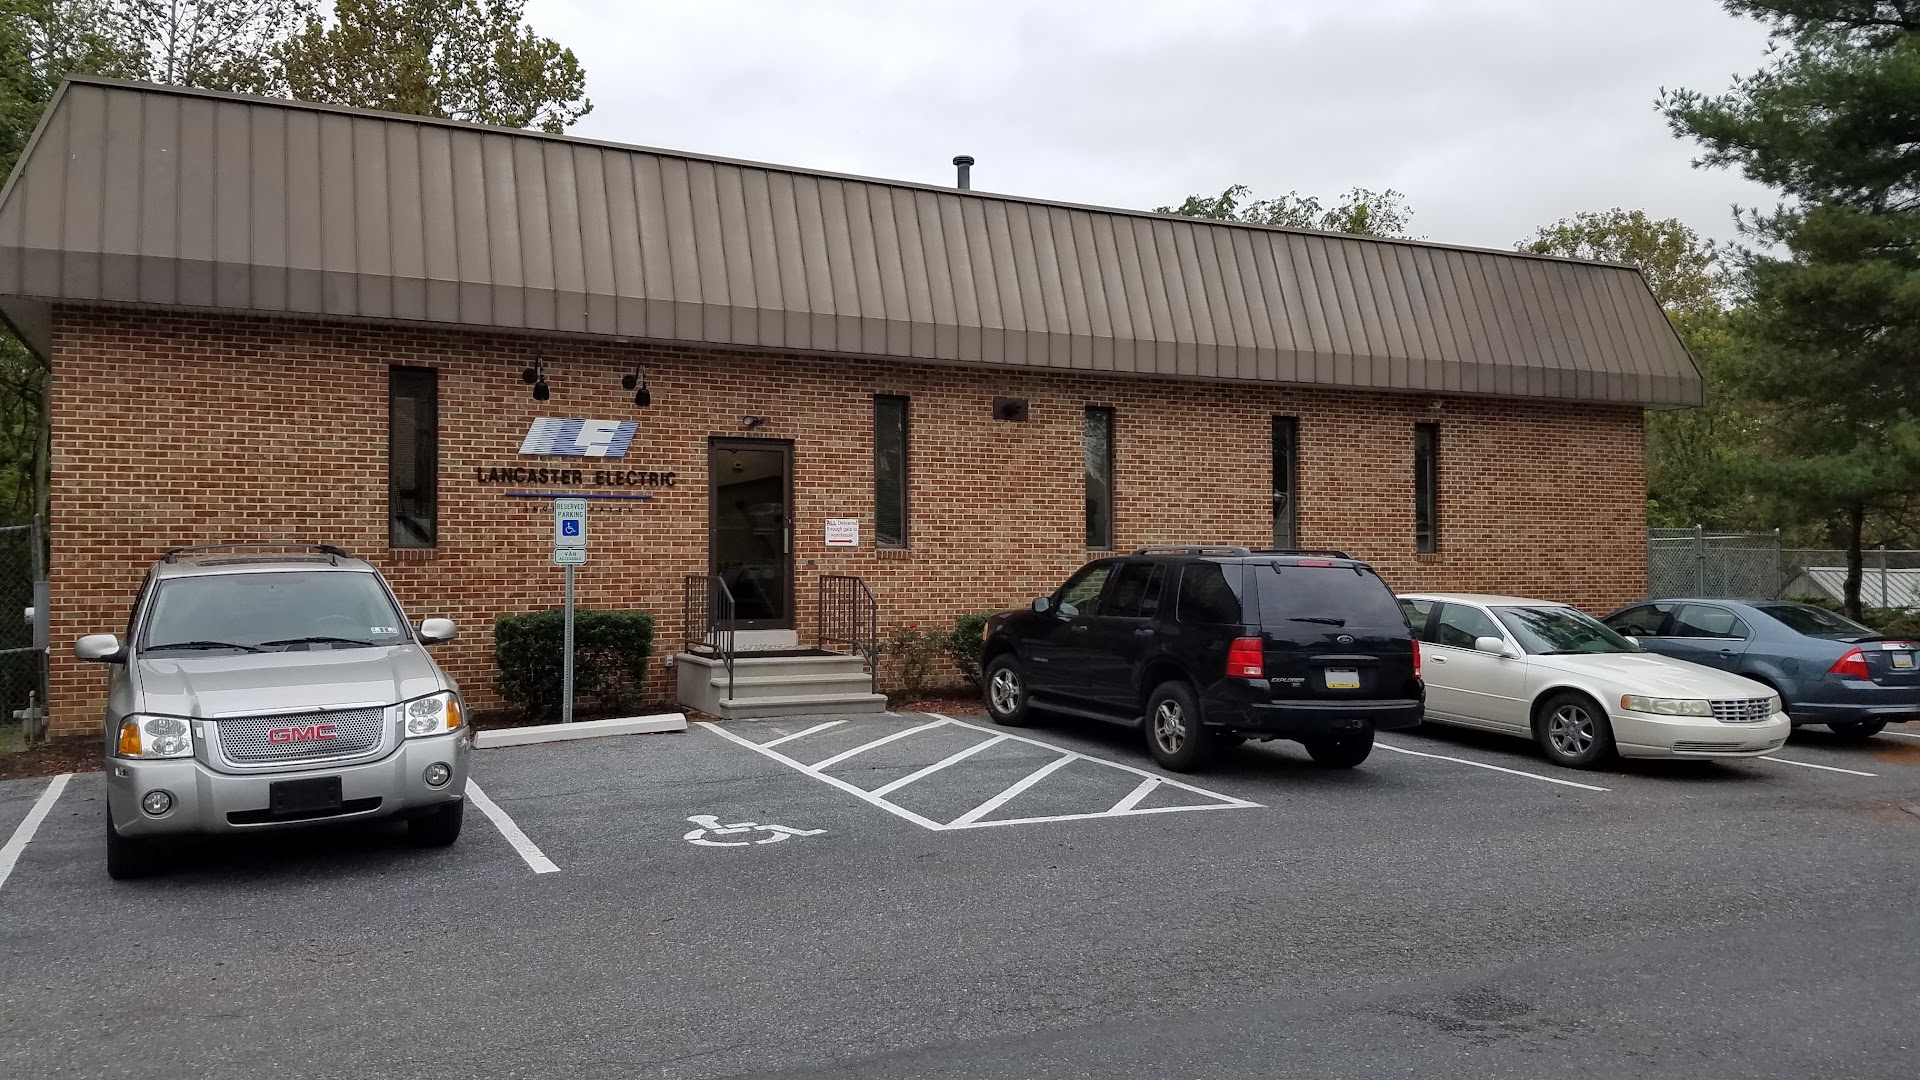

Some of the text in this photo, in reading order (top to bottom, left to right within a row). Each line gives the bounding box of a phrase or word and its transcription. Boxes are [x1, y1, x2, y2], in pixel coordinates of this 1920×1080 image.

[477, 466, 676, 486] LANCASTER ELECTRIC
[269, 724, 336, 744] GMC
